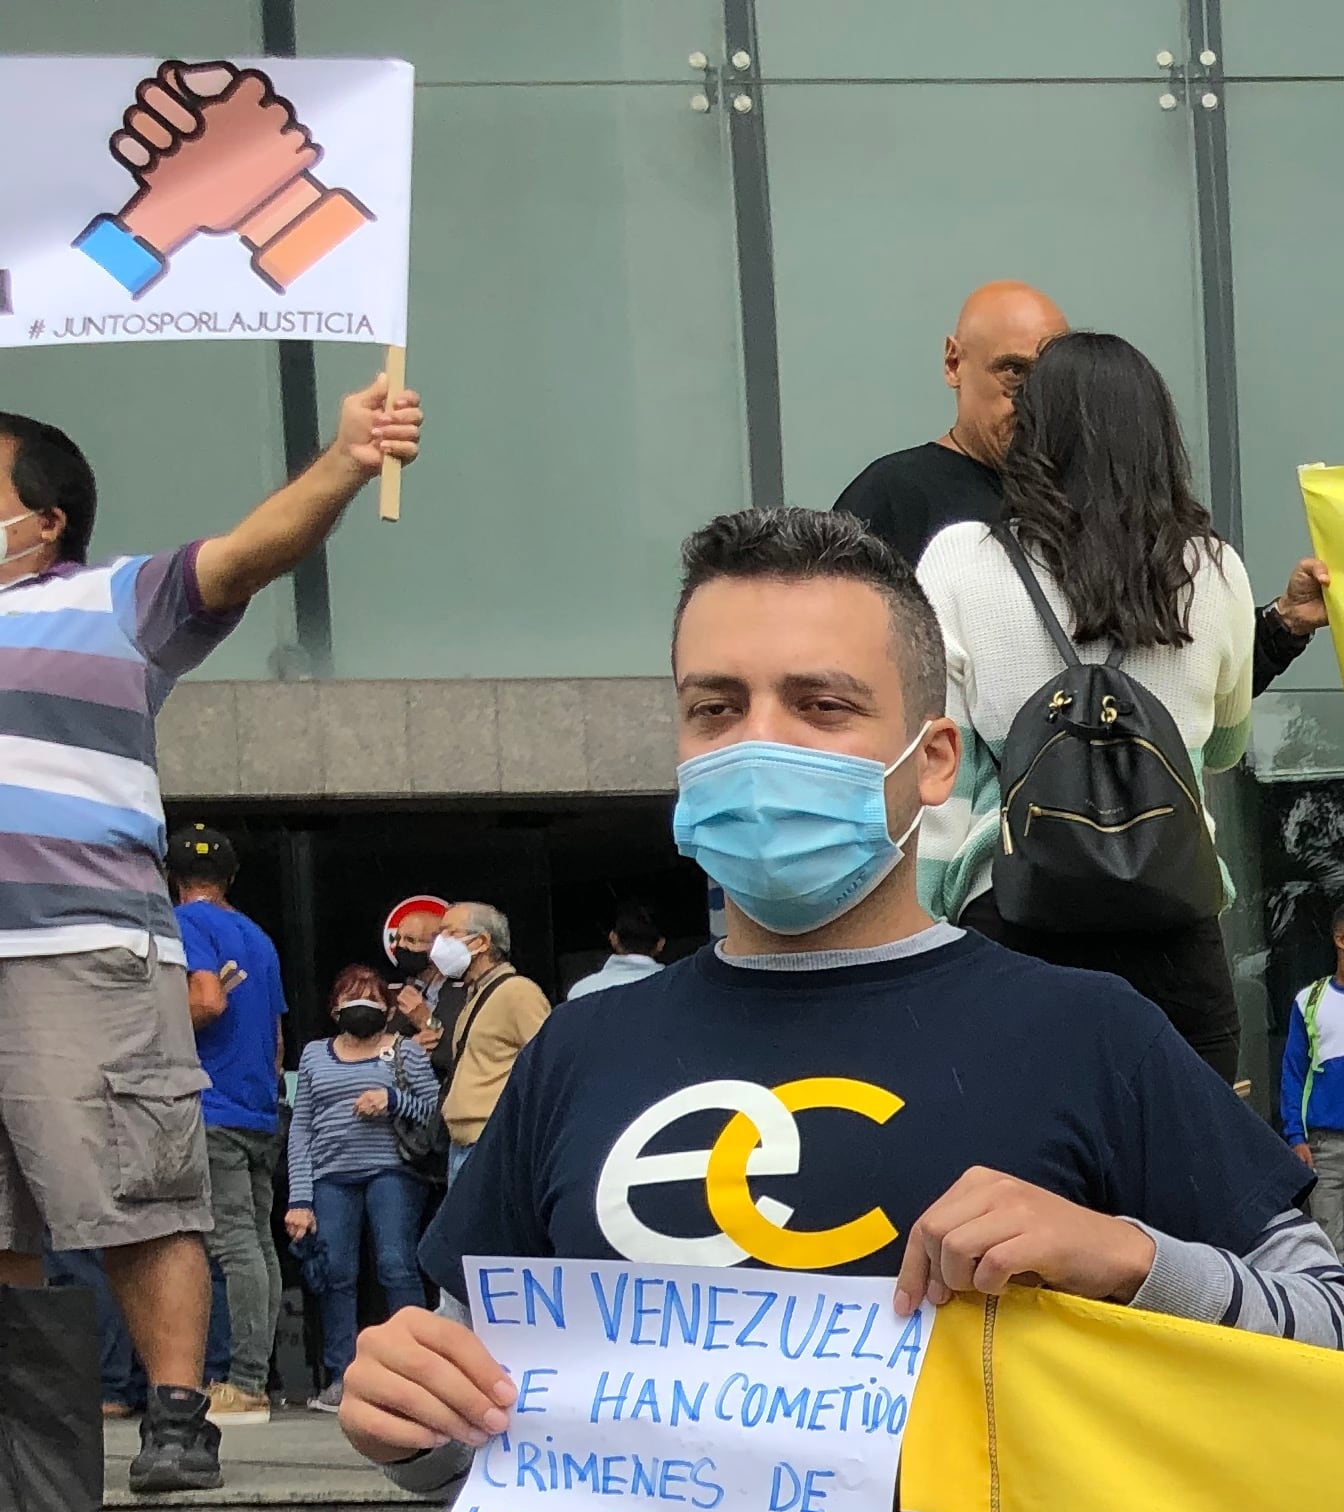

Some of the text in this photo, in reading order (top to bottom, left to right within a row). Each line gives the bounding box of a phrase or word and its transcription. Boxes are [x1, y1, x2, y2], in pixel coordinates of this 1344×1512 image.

[478, 1266, 923, 1377] EN VENEZUELA
[499, 1363, 559, 1414] E
[589, 1371, 709, 1429] HAN
[481, 1430, 724, 1511] CRIMENES
